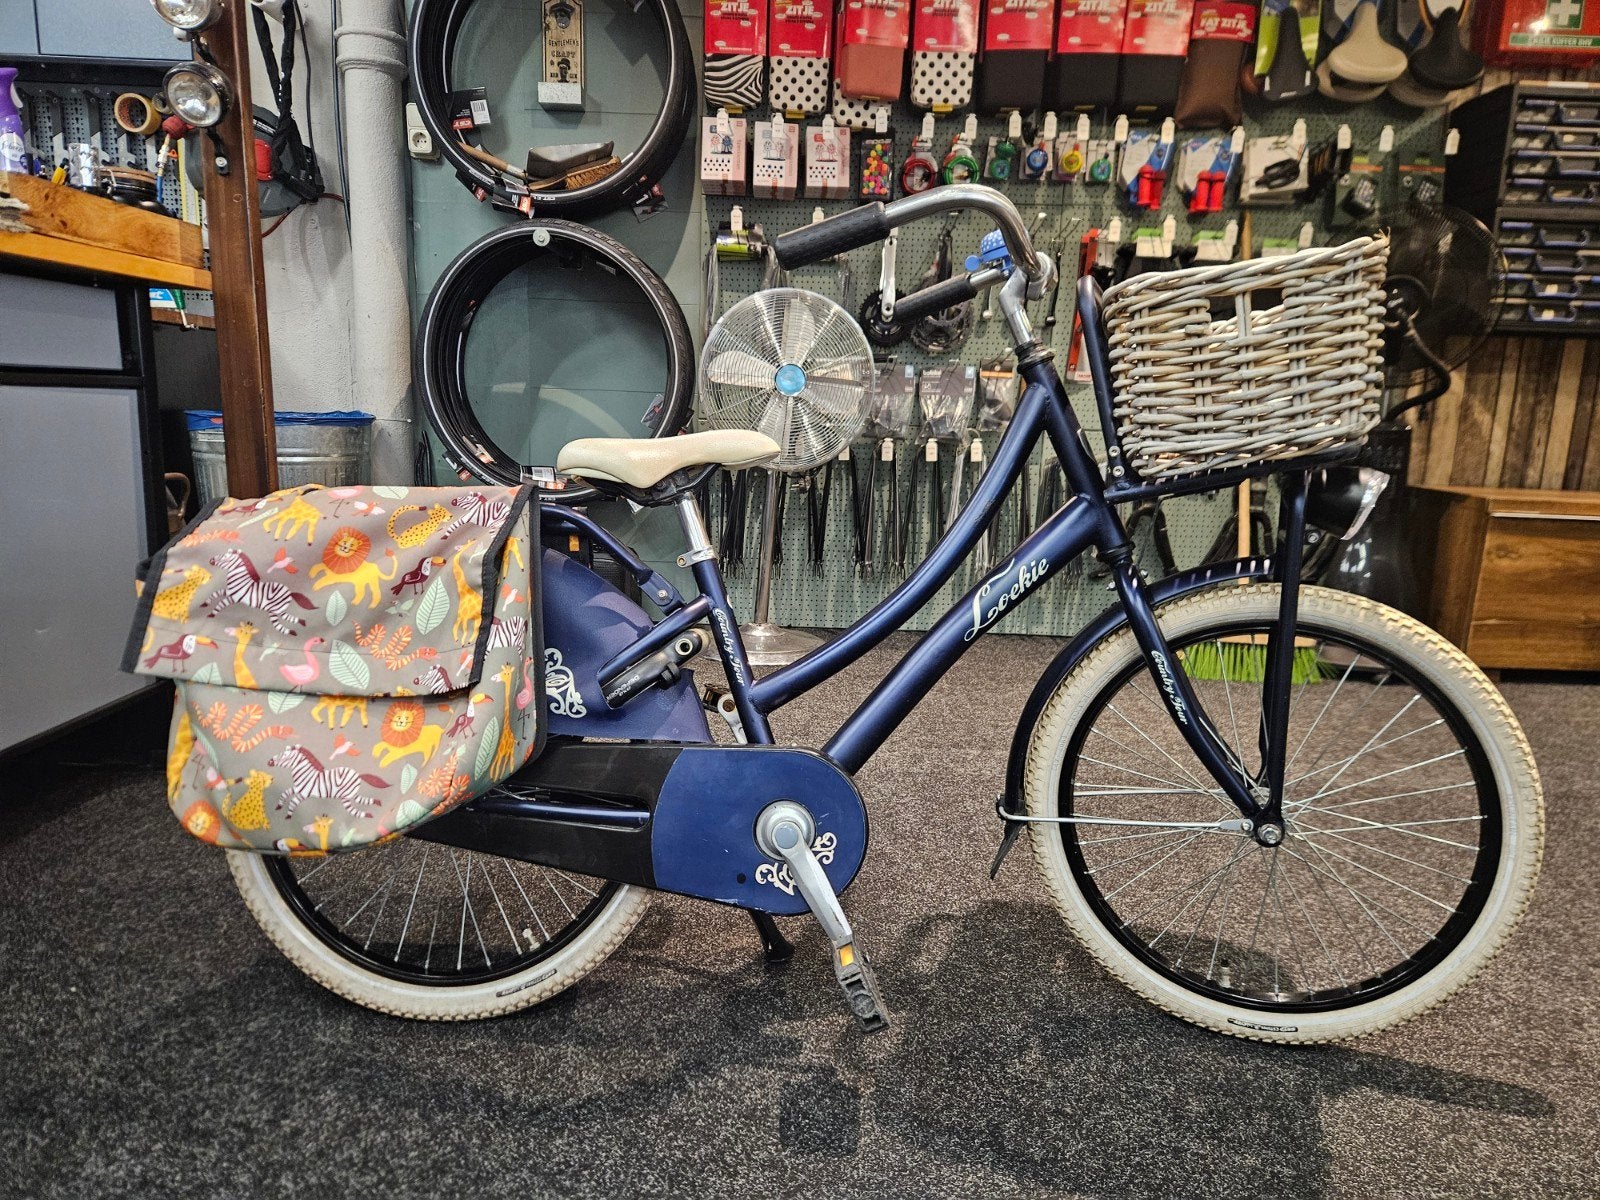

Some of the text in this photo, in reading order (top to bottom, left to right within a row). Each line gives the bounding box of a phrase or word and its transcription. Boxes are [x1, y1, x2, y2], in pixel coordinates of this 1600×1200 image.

[720, 2, 749, 13] ZITJE
[786, 5, 815, 15] ZITJE
[963, 557, 1050, 642] Loekie
[712, 607, 745, 686] Country Tour
[1151, 650, 1188, 725] Country Tour
